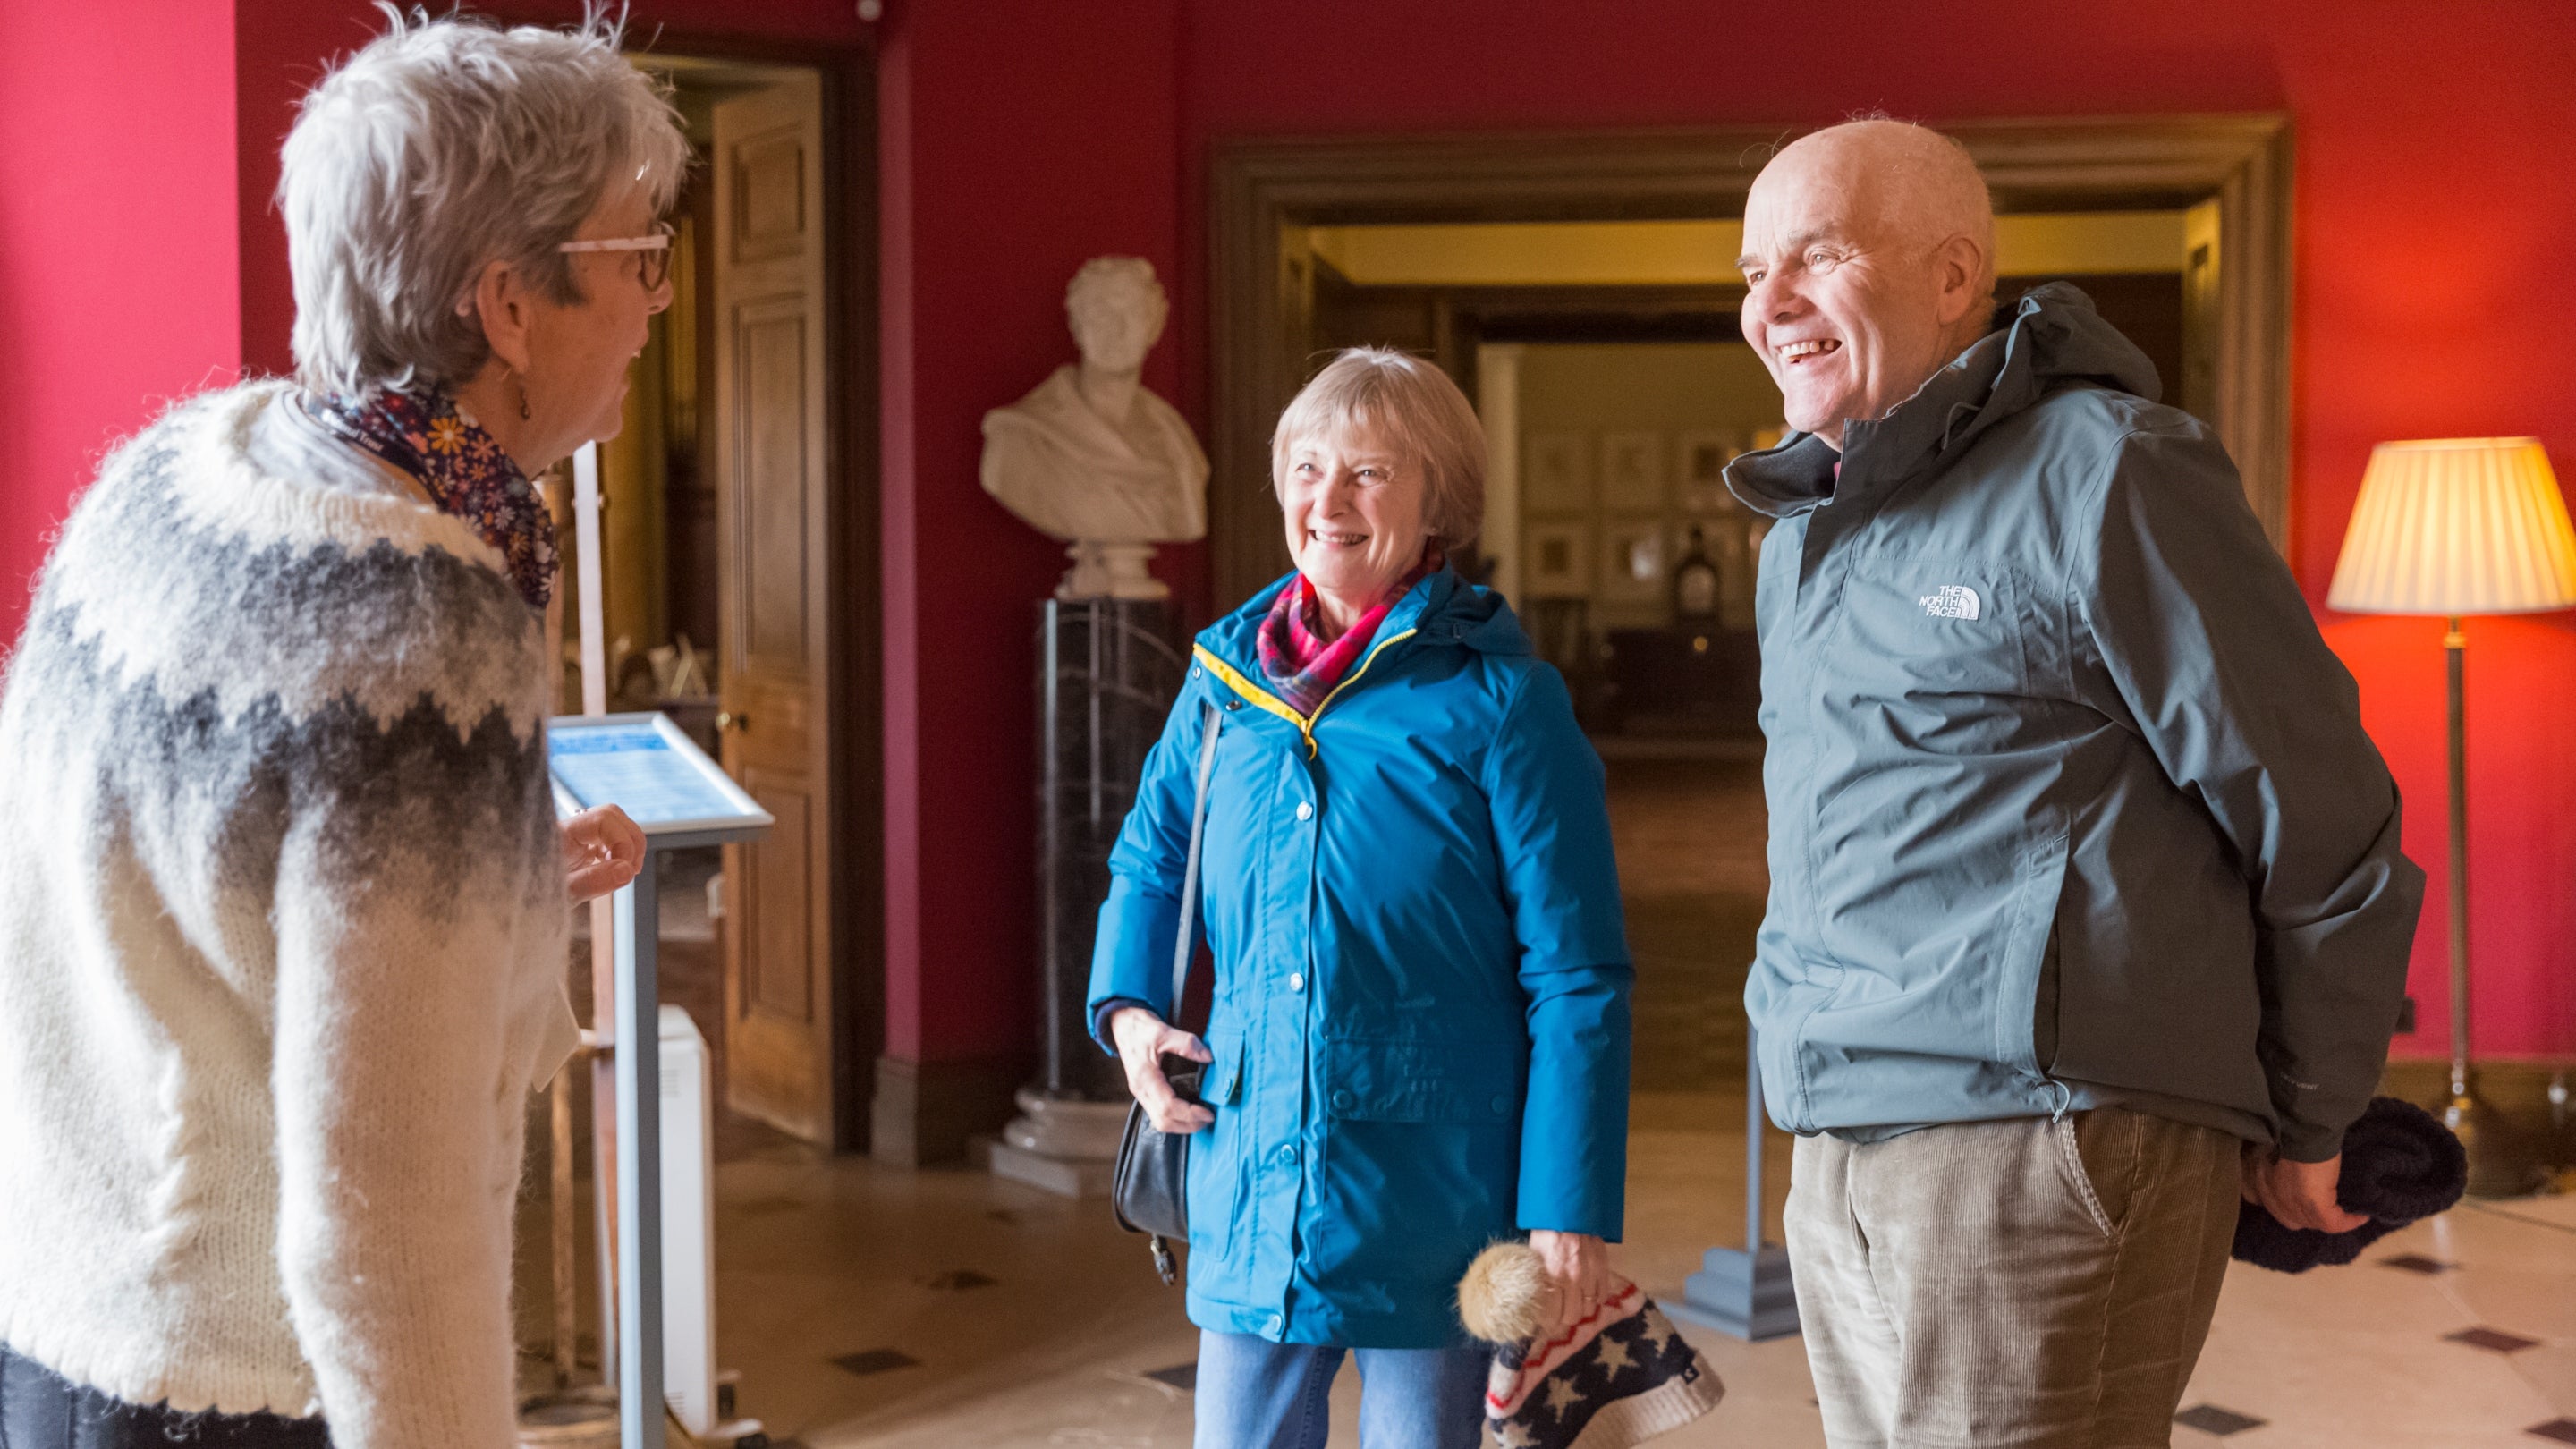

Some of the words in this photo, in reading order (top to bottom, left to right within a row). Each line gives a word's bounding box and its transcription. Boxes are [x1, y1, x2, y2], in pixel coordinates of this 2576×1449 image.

[1939, 585, 1962, 597] THE
[1919, 595, 1960, 607] NORTH
[1926, 606, 1957, 618] FACE
